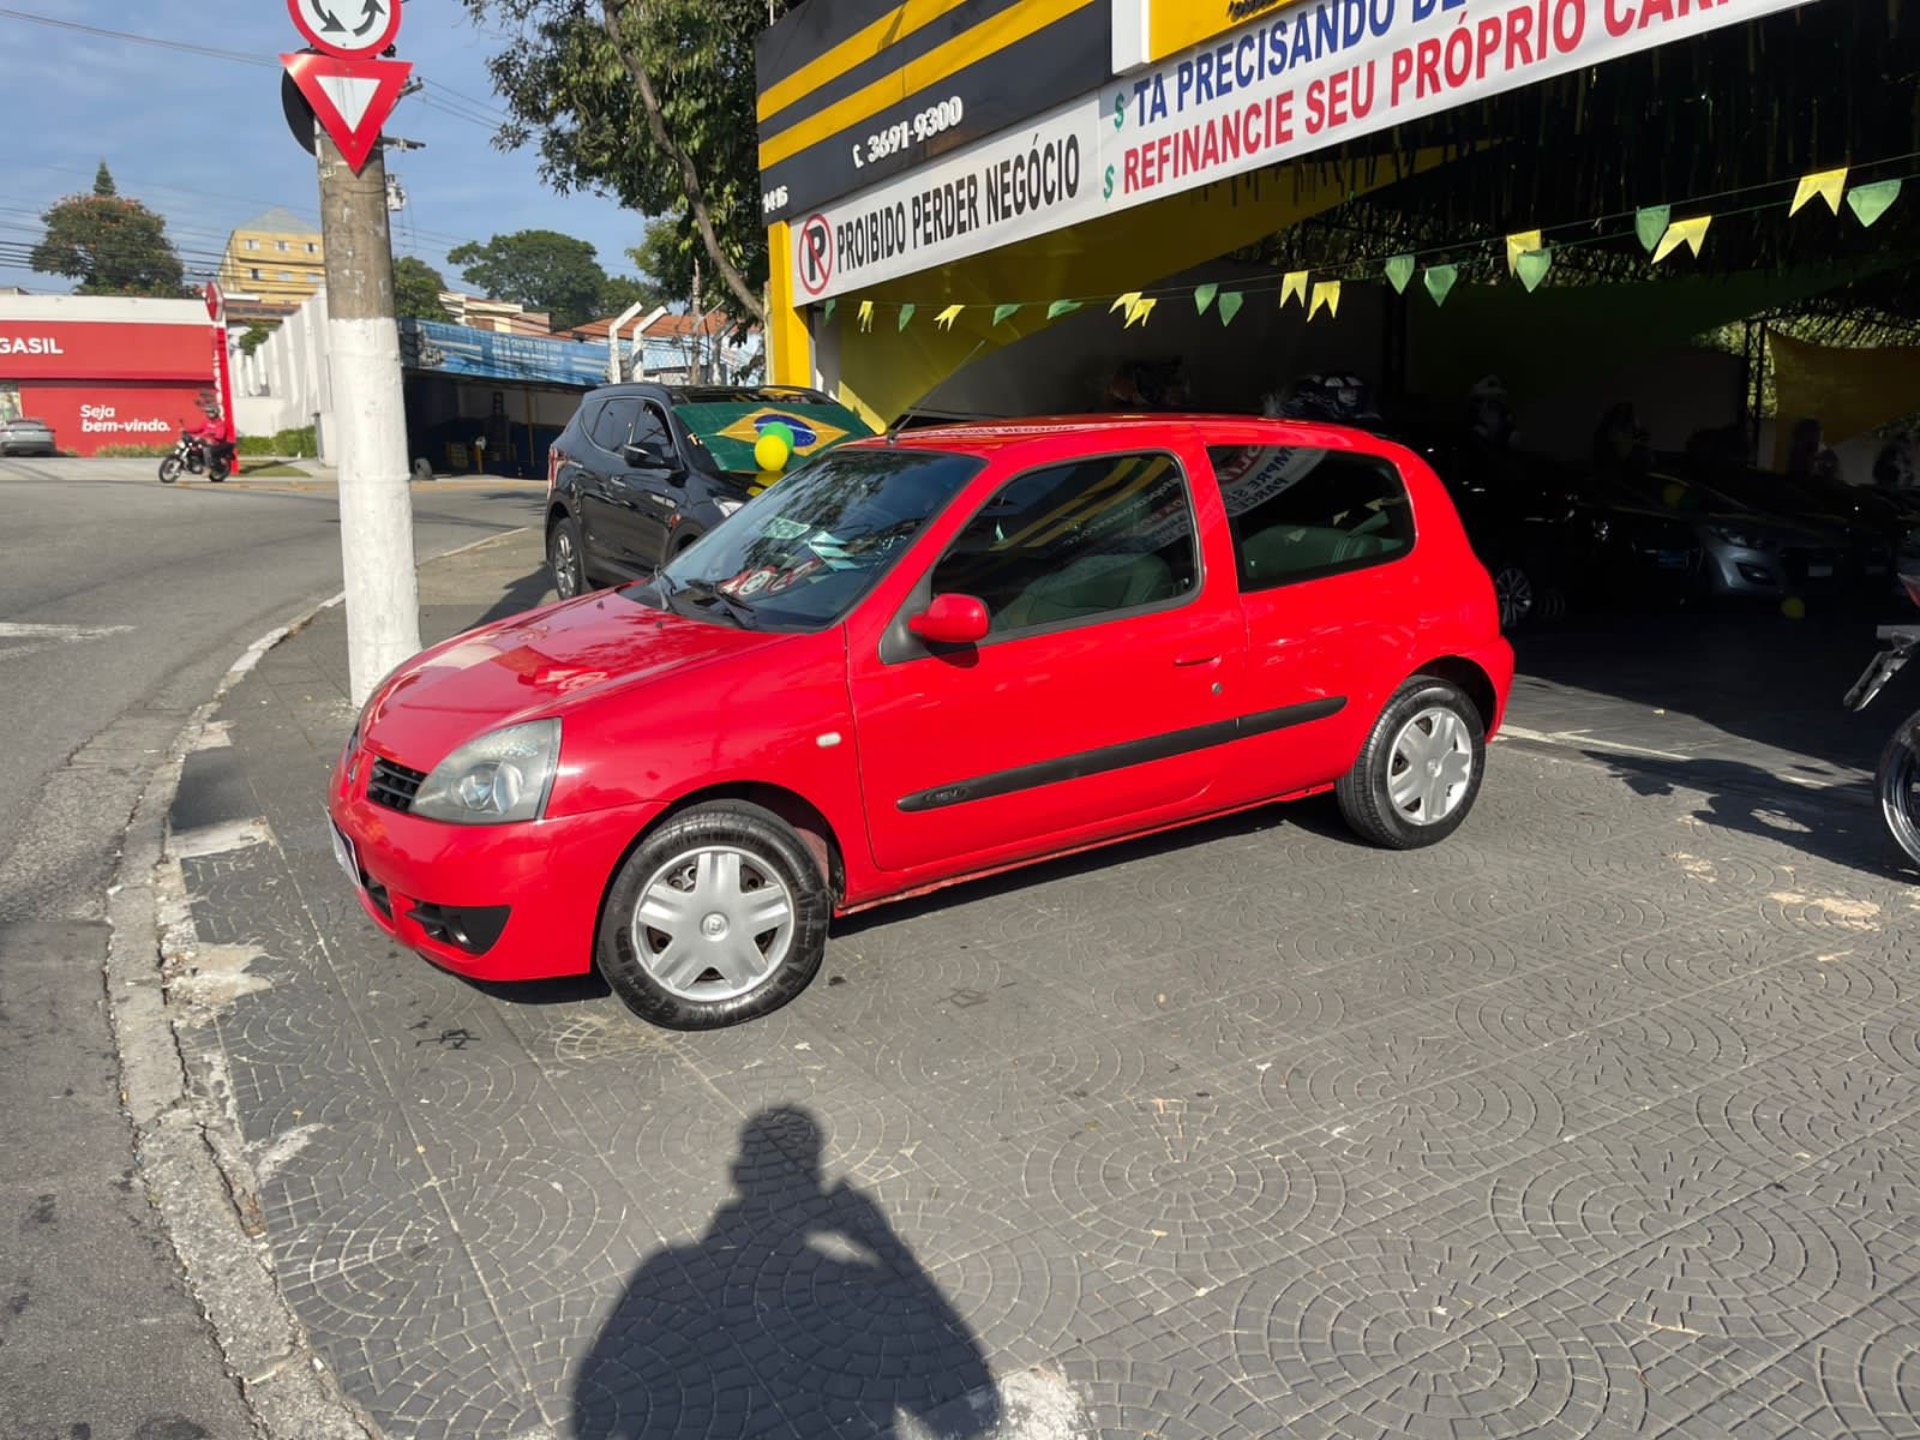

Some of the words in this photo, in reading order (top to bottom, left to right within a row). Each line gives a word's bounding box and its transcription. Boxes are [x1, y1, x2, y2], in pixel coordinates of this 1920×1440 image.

[1124, 89, 1294, 194] REFINANCIE
[1305, 60, 1375, 135] SEU
[1390, 0, 1586, 107] PRÓPRIO
[1134, 73, 1168, 127] TA
[1177, 0, 1395, 112] PRECISANDO
[867, 96, 963, 163] 3691-9300
[837, 201, 906, 274] PROIBIDO
[912, 173, 980, 250] PERDER
[985, 133, 1080, 225] NEGÓCIO
[80, 404, 115, 420] Seja
[82, 418, 171, 432] bem-vindo.
